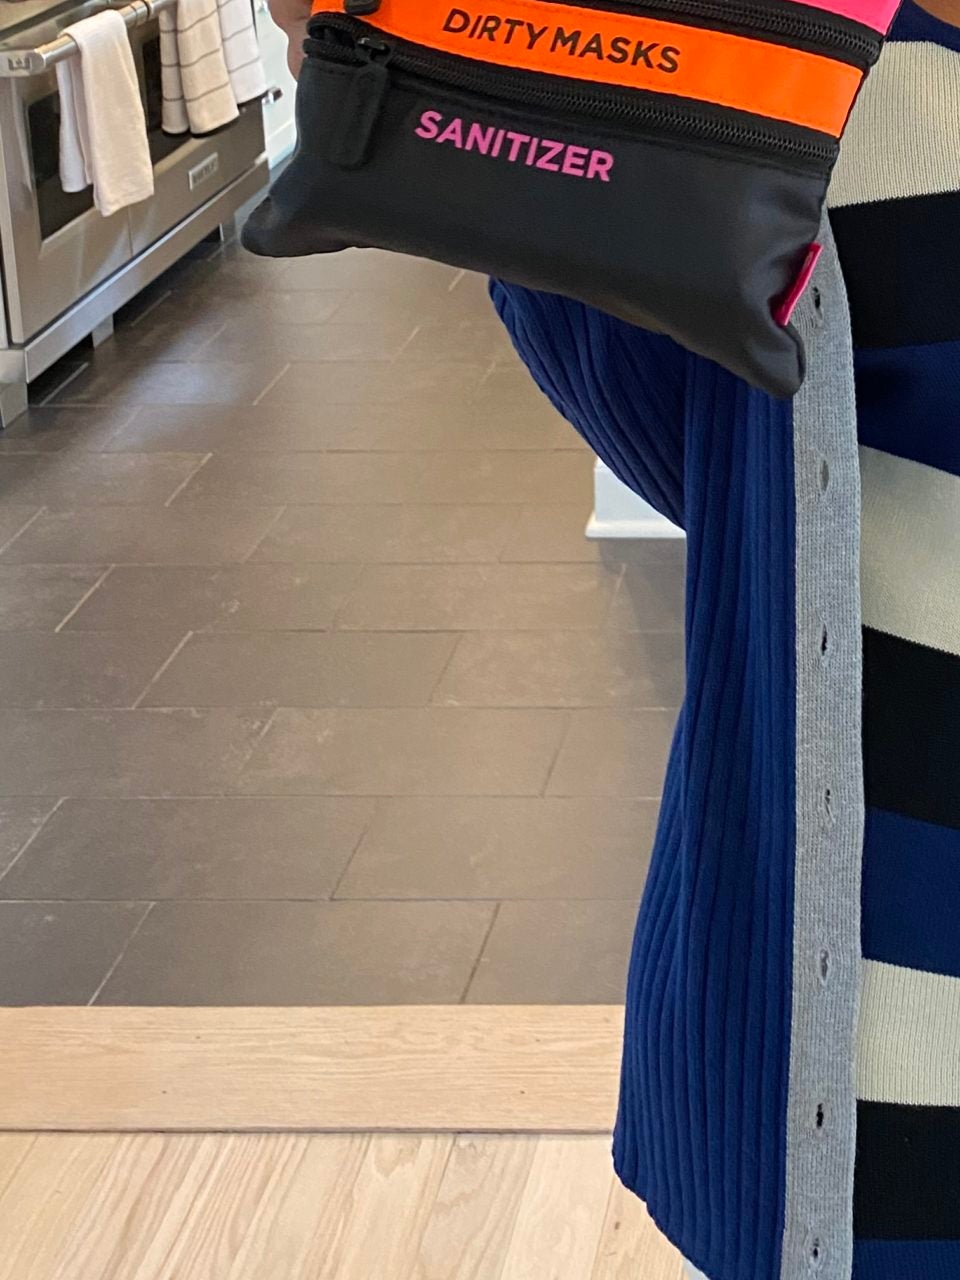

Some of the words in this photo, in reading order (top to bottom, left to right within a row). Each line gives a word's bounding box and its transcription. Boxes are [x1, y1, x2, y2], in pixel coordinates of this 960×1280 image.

[442, 8, 548, 50] DIRTY
[550, 26, 680, 74] MASKS
[415, 110, 614, 182] SANITIZER
